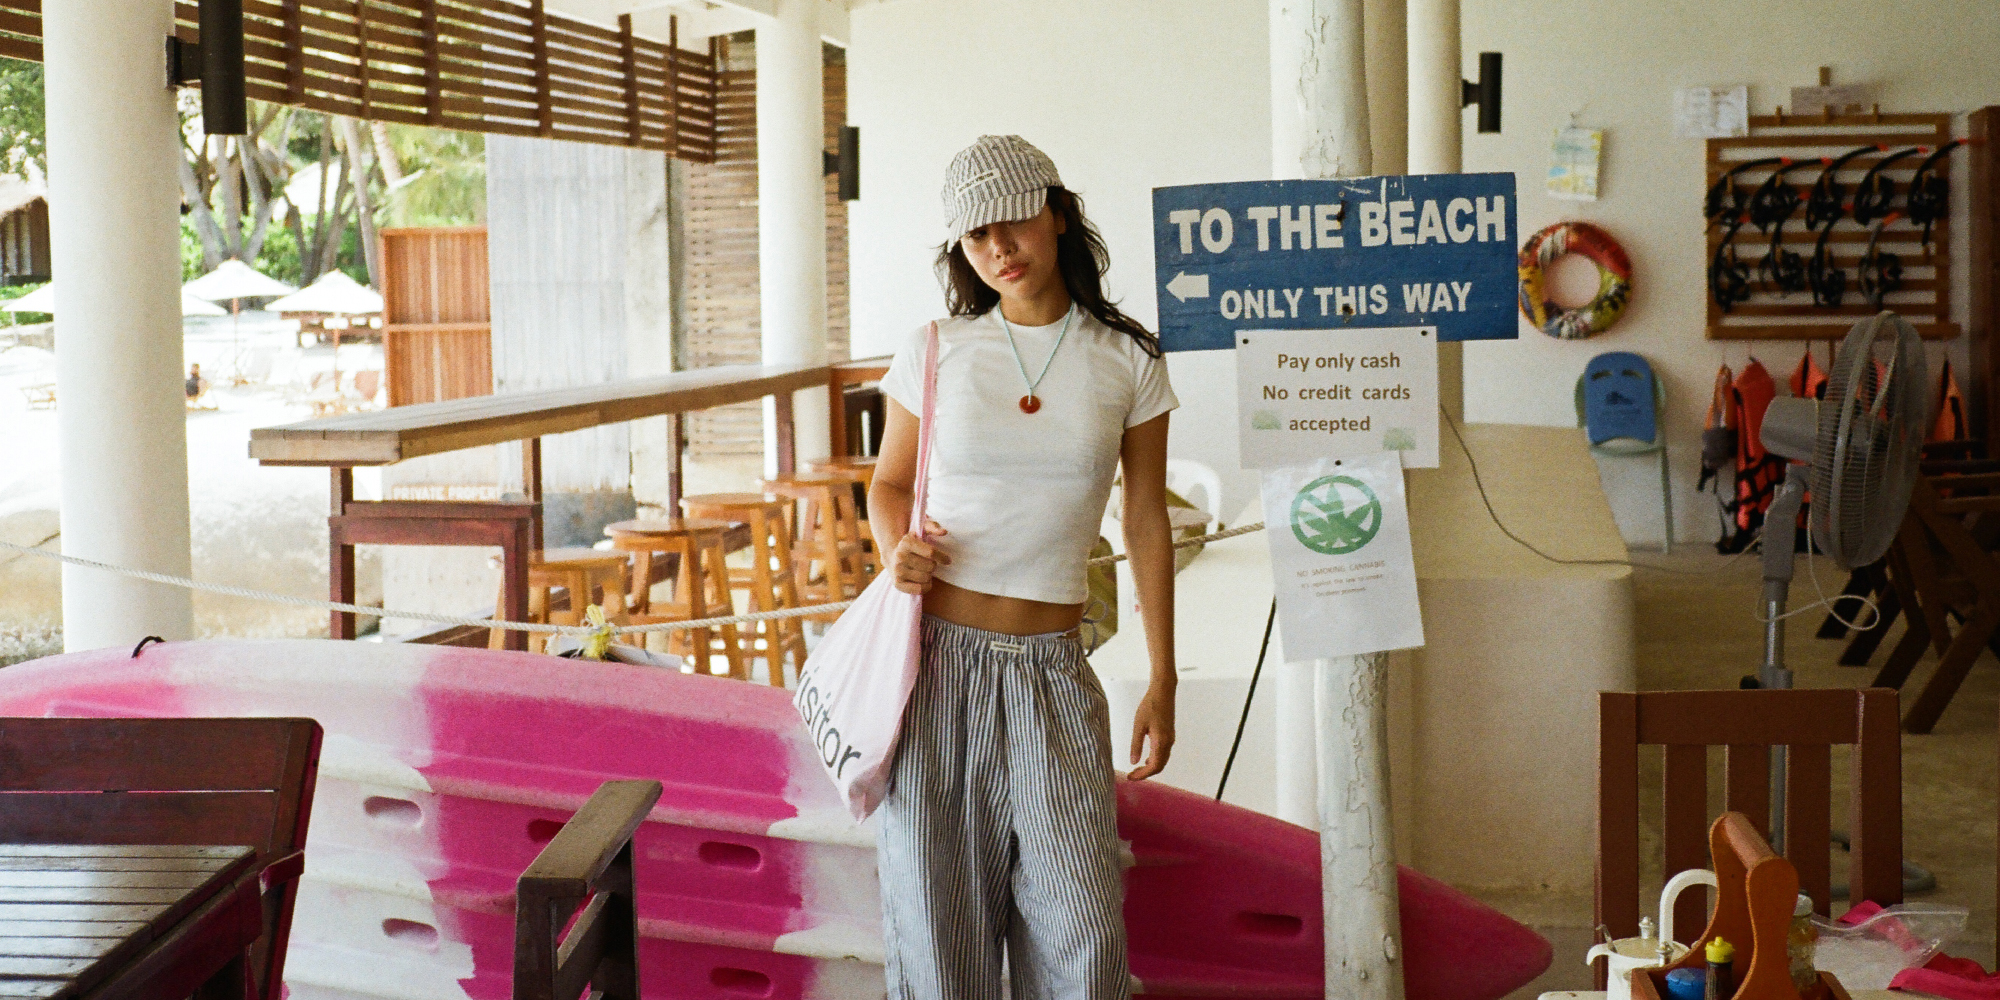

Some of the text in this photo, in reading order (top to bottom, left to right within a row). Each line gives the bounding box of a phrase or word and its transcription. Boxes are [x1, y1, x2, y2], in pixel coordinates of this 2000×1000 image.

[1169, 195, 1506, 254] TO THE BEACH
[1220, 281, 1473, 320] ONLY THIS WAY
[1277, 352, 1400, 372] Pay only cash
[1263, 384, 1411, 400] No credit cards
[1289, 415, 1371, 434] accepted
[393, 486, 445, 501] PRIVATE
[1296, 560, 1386, 578] NO SMOKING CANNABIS
